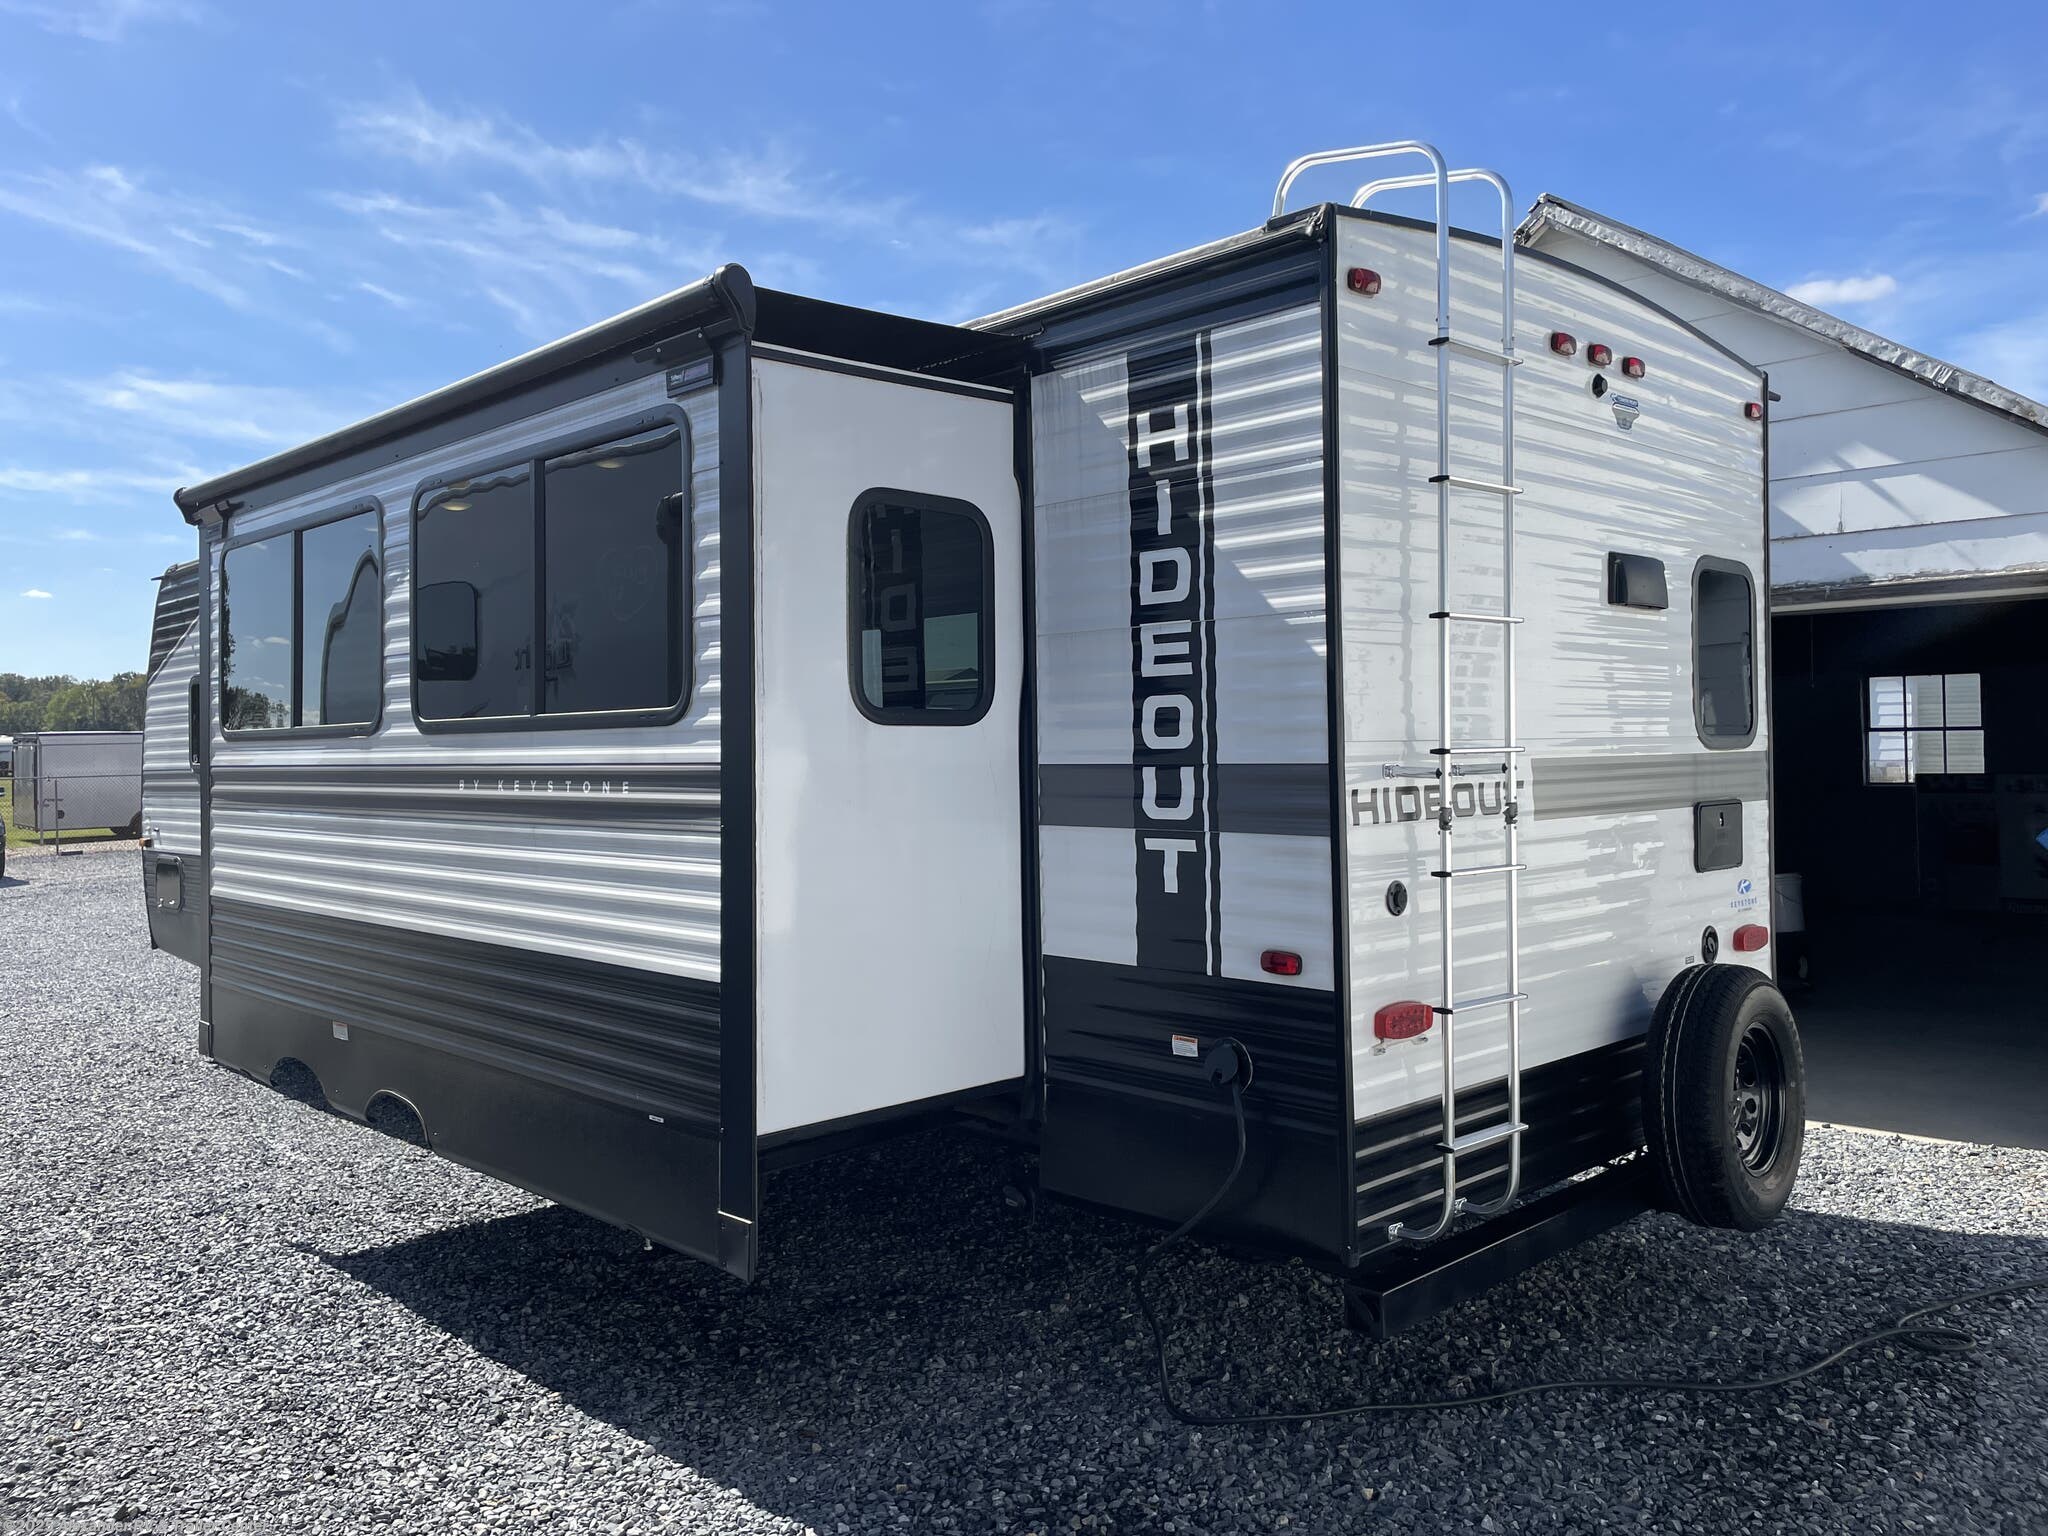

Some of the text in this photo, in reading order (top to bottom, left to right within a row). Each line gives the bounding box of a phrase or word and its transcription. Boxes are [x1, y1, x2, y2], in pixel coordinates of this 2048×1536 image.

[1137, 403, 1198, 894] HIDEOUT
[458, 779, 630, 794] BY KEYSTONE
